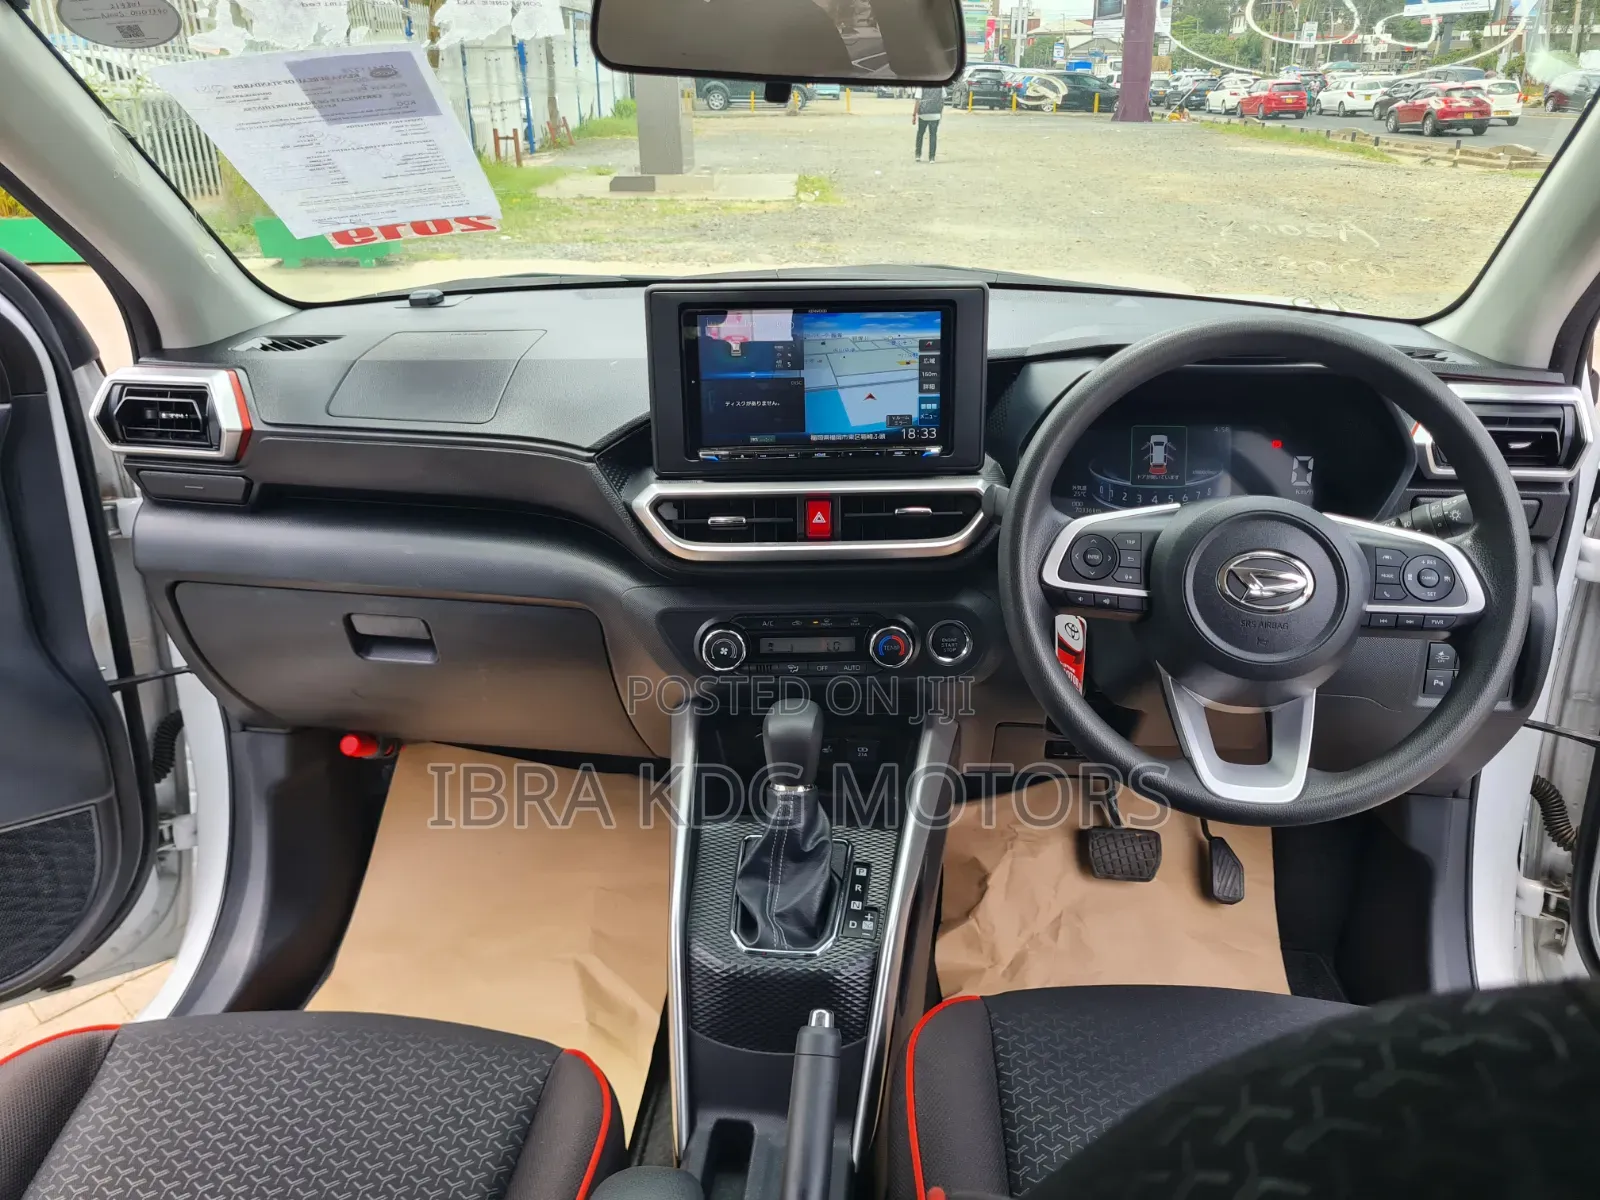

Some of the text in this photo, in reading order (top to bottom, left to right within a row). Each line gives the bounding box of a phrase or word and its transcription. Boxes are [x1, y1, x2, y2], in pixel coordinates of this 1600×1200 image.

[724, 399, 781, 408] ディスクがありません。
[901, 427, 937, 440] 18:33
[1290, 455, 1314, 487] 0
[761, 619, 774, 627] A/C
[843, 664, 861, 672] AUTO
[855, 884, 862, 892] R
[848, 920, 857, 928] D
